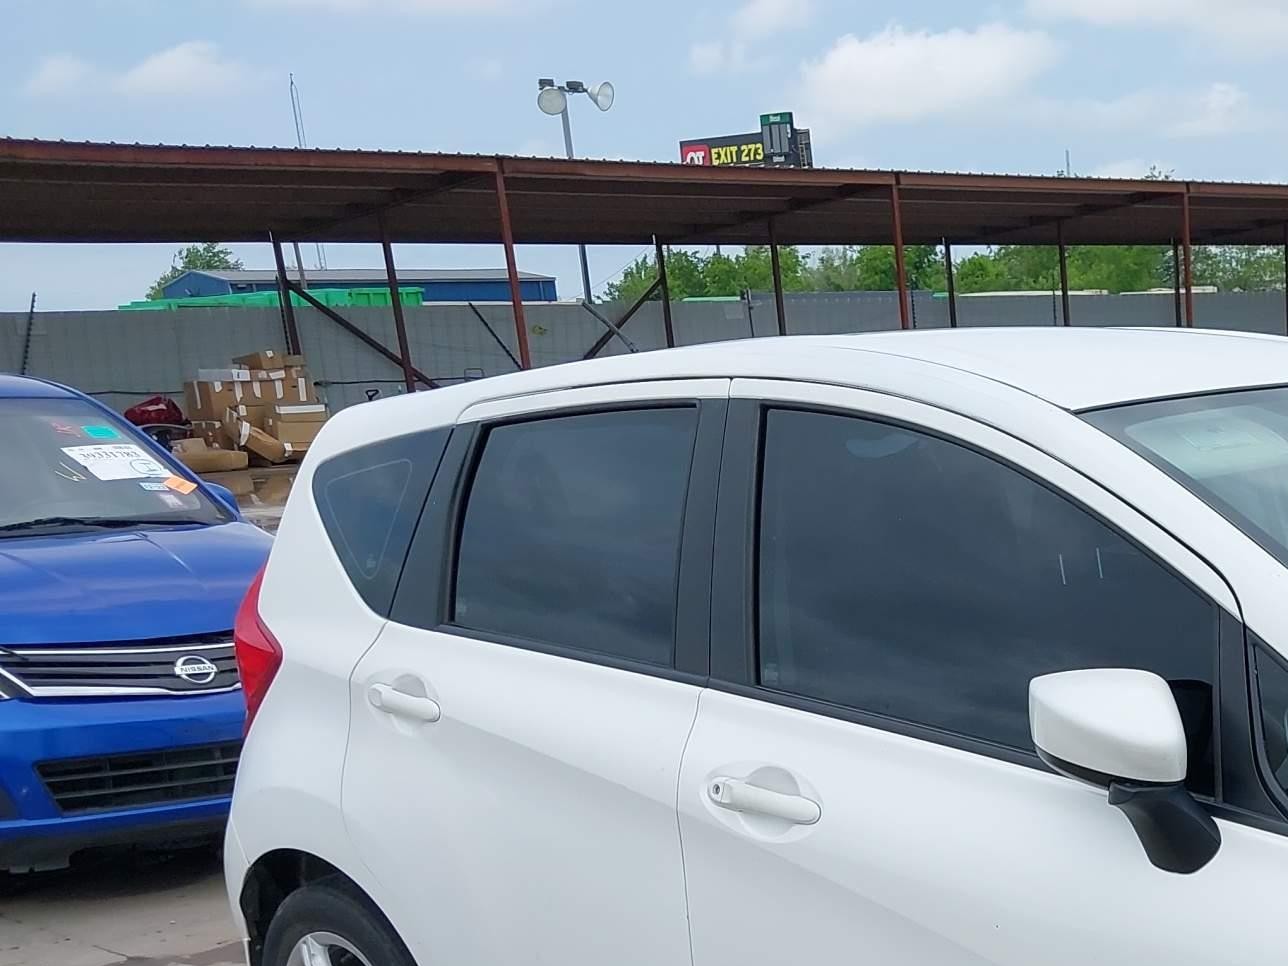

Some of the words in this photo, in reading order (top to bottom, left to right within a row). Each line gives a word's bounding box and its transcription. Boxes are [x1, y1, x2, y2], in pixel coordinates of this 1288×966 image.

[711, 146, 738, 166] EXIT
[741, 143, 764, 162] 273
[180, 665, 215, 673] NISSAN
